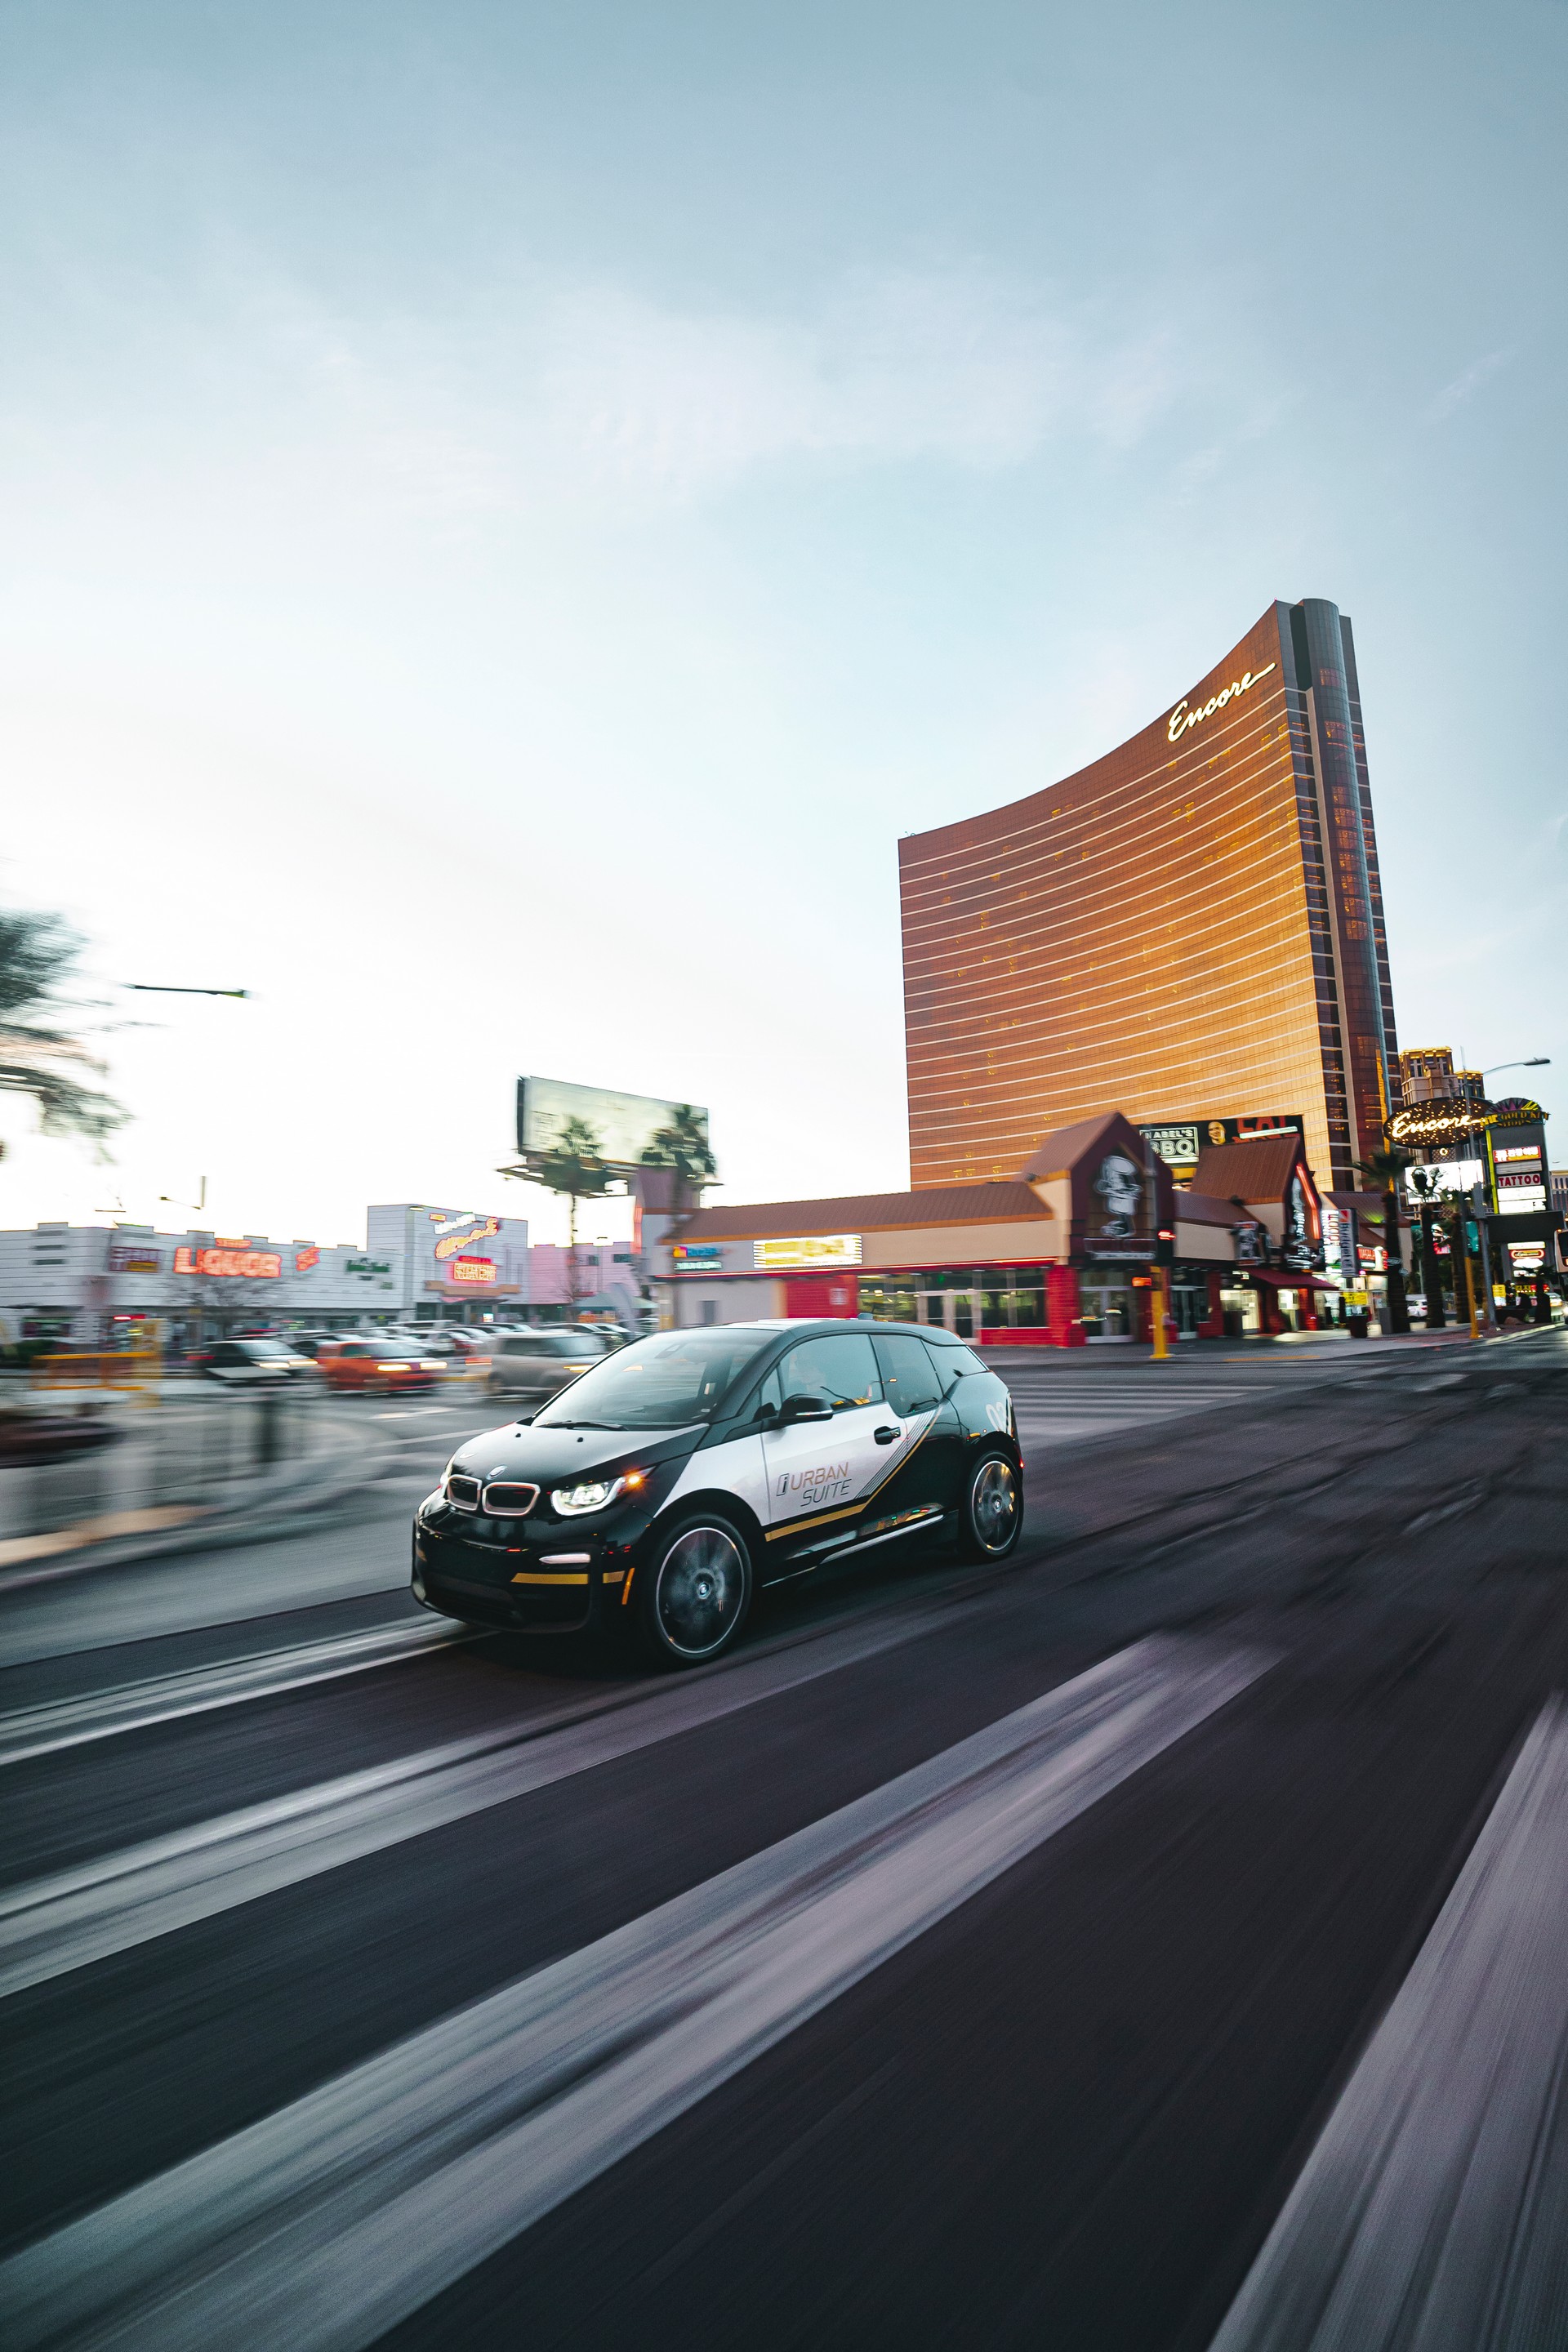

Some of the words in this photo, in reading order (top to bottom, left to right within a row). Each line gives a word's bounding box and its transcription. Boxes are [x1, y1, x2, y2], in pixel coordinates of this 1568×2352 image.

[1168, 662, 1276, 742] Encore
[1392, 1112, 1482, 1138] Encore
[1499, 1174, 1540, 1187] TATTOO
[791, 1462, 849, 1490] URBAN
[800, 1478, 853, 1507] SUITE
